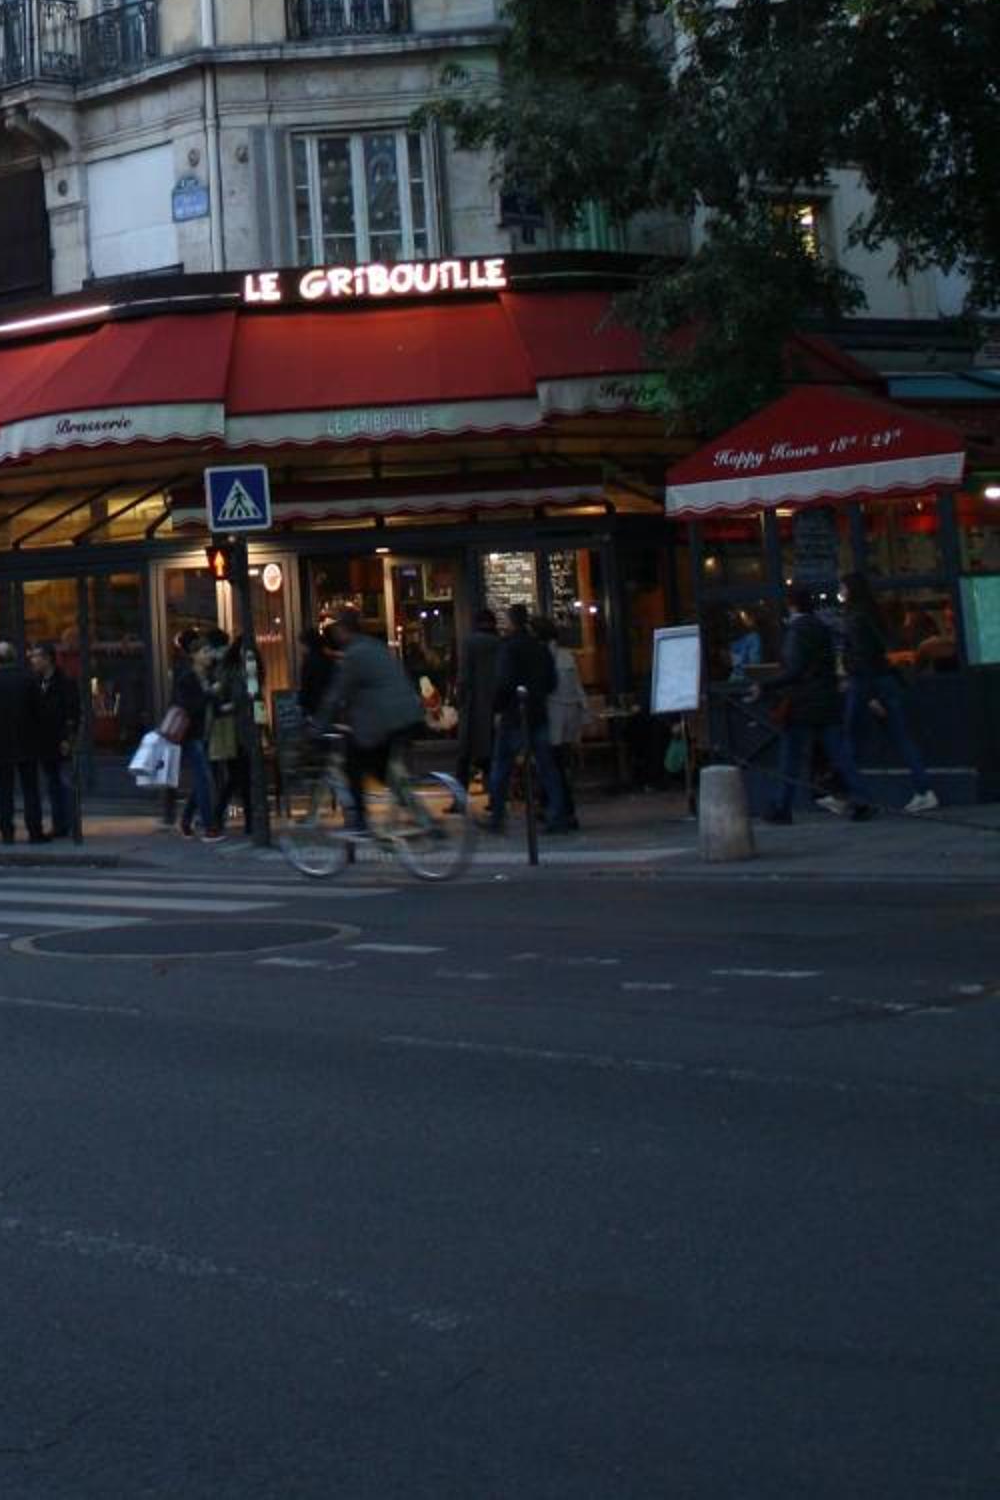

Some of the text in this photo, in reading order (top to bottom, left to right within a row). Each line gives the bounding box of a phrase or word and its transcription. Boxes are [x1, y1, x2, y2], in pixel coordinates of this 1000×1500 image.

[244, 272, 281, 302] LE
[55, 414, 133, 435] Brasserie
[713, 449, 764, 470] Happy
